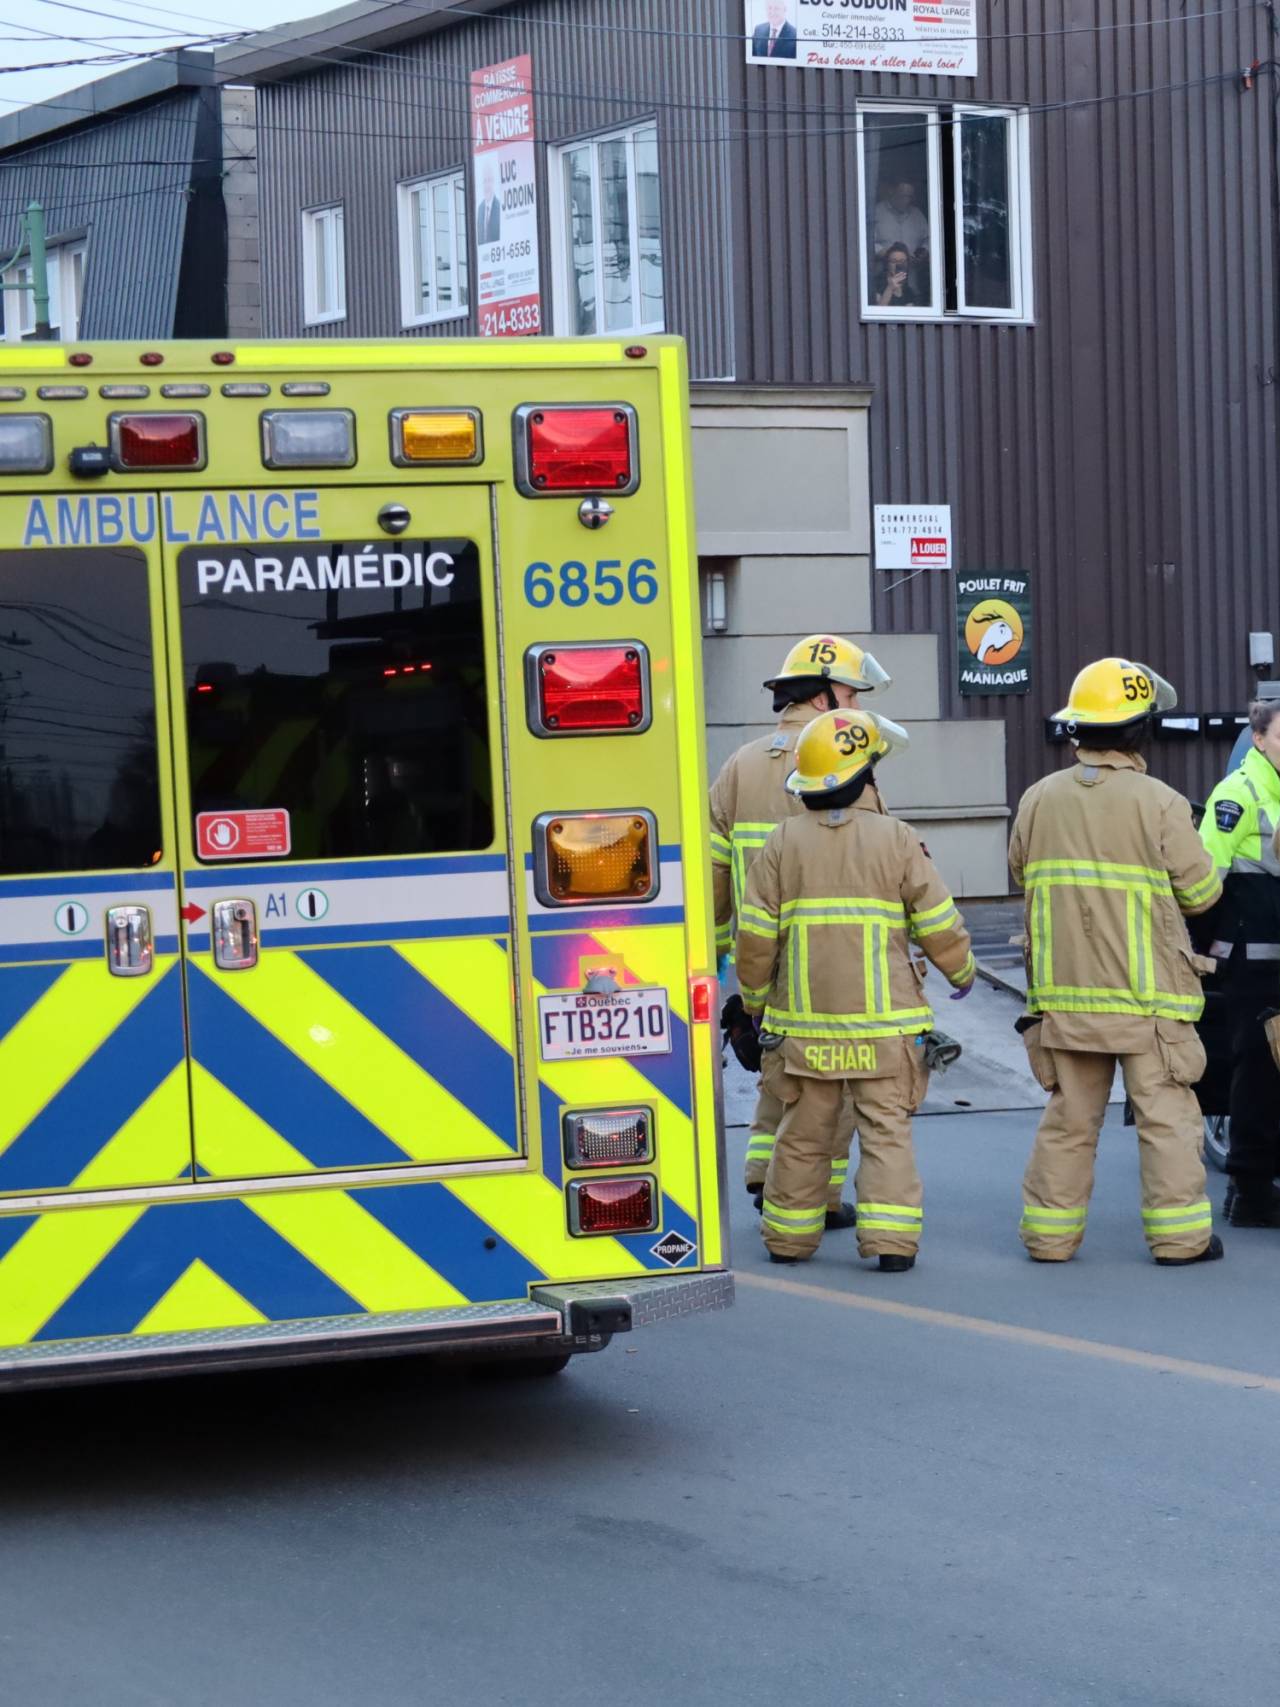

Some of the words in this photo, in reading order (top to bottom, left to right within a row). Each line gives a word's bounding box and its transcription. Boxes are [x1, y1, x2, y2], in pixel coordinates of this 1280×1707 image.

[822, 11, 848, 20] Courtier
[851, 14, 885, 22] immobilier
[913, 5, 940, 15] ROYAL
[822, 24, 905, 41] 514-214-8333
[807, 52, 829, 65] Pas
[834, 53, 866, 66] besoin
[870, 54, 906, 67] d'aller
[909, 57, 933, 70] plus
[937, 58, 963, 70] loin!
[474, 80, 527, 109] COMMERCIAL
[485, 104, 530, 144] VENDRE
[500, 159, 517, 184] LUC
[501, 183, 534, 212] JODOIN
[490, 240, 531, 264] 691-6556
[484, 303, 540, 336] 214-8333
[22, 491, 321, 546] AMBULANCE
[919, 542, 946, 554] LOUER
[197, 545, 455, 594] PARAMÉDIC
[523, 558, 659, 609] 6856
[958, 578, 1001, 594] POULET
[1003, 579, 1027, 594] FRIT
[808, 643, 837, 665] 15
[961, 668, 1029, 686] MANIAQUE
[1122, 675, 1150, 701] 59
[834, 725, 870, 756] 39
[265, 892, 287, 918] A1
[544, 1004, 664, 1045] FTB3210
[571, 1046, 582, 1055] Je
[600, 1044, 641, 1053] souviens
[804, 1044, 877, 1071] SEHARI
[657, 1243, 690, 1254] PROPANE
